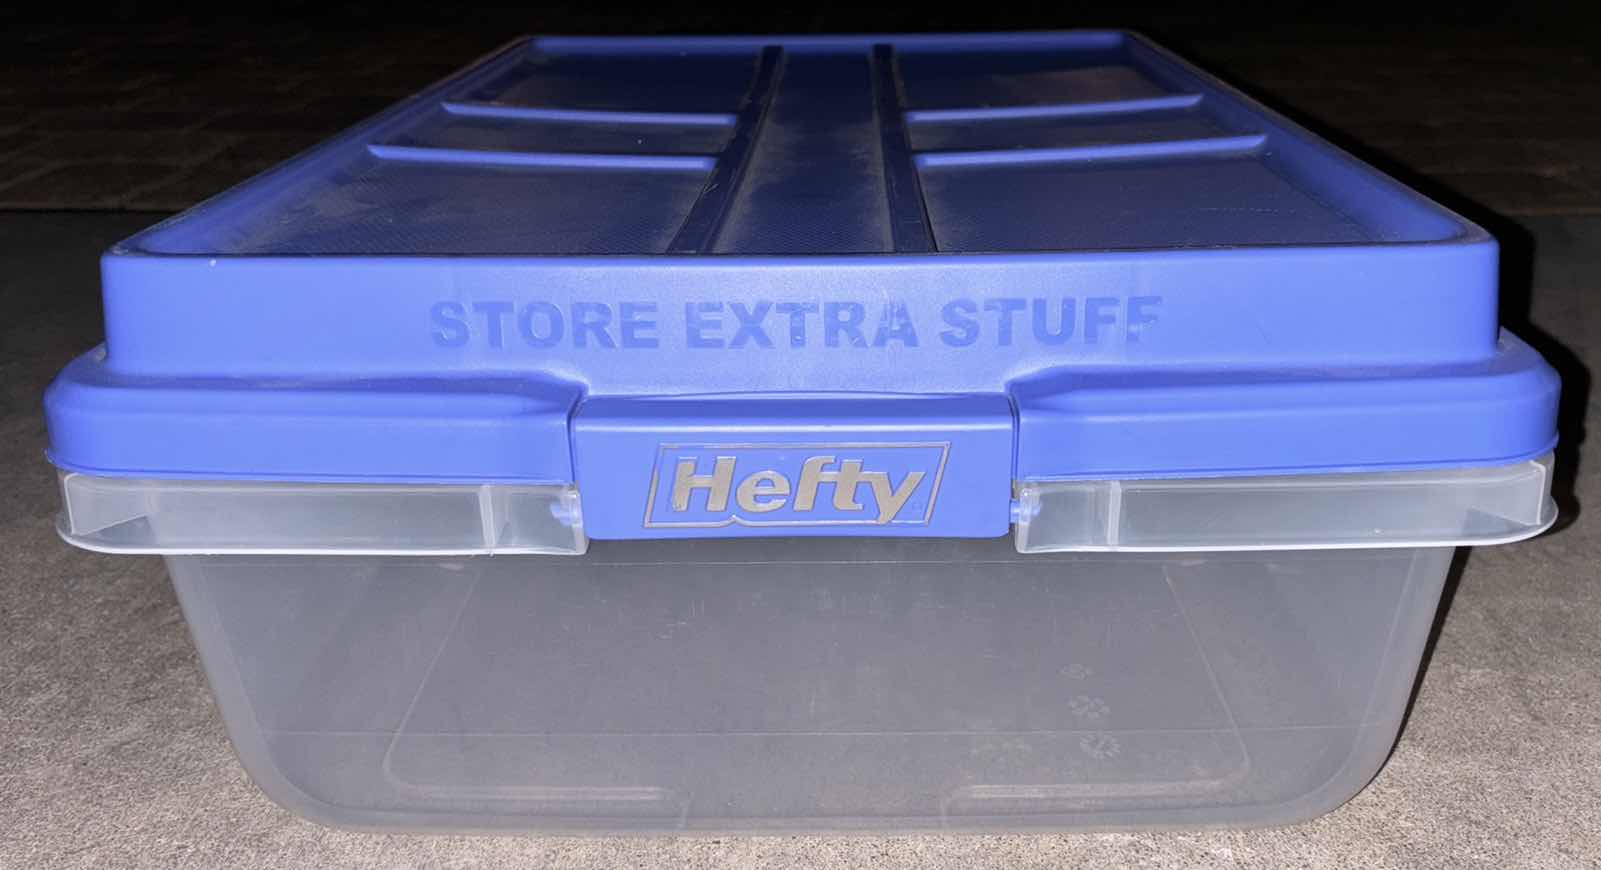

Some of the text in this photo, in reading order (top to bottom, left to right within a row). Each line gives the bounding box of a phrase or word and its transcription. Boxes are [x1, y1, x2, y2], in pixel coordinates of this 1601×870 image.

[430, 297, 1163, 349] STORE EXTRA STUFF
[672, 455, 926, 525] Hefty
